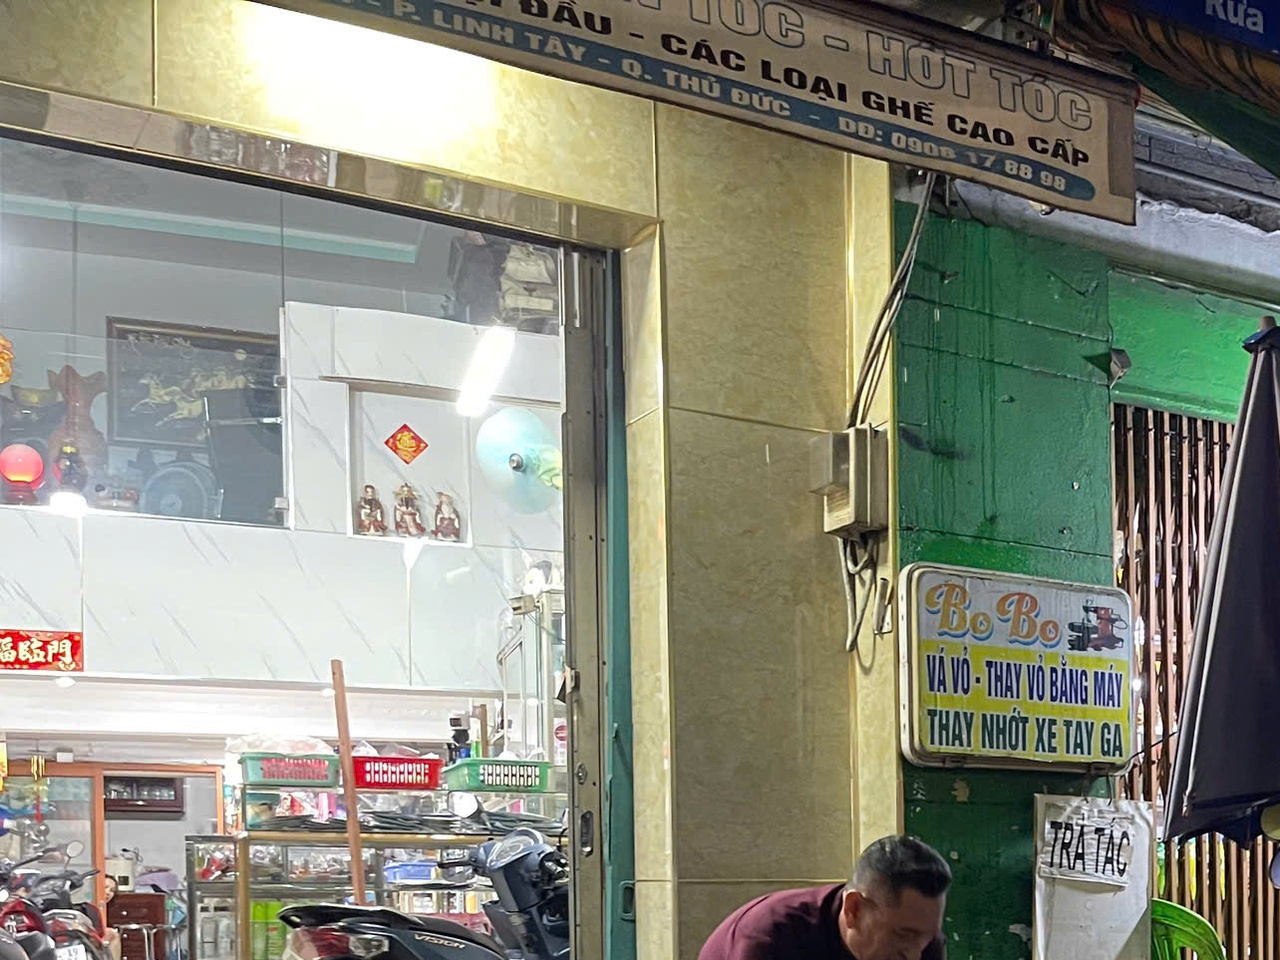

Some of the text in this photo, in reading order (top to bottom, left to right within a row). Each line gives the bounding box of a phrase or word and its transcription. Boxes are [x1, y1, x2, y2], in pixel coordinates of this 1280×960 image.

[433, 9, 515, 45] LINH
[525, 31, 587, 61] TÂY
[621, 58, 653, 80] Q.
[662, 68, 722, 99] THỦ
[1004, 159, 1033, 181] 88
[1039, 172, 1067, 191] 98
[661, 33, 746, 72] CÁC
[761, 59, 848, 103] LOẠI
[861, 90, 935, 126] GHẾ
[947, 114, 1015, 147] CAO
[1028, 136, 1090, 167] CẤP
[925, 582, 1062, 649] Bo Bo
[926, 647, 947, 695] VÁ
[951, 646, 971, 696] VỎ
[985, 660, 1023, 699] THAY
[1027, 653, 1045, 702] VỎ
[1050, 655, 1089, 706] BẰNG
[1093, 663, 1123, 708] MÁY
[927, 706, 1124, 758] THAY NHỚT XE TAY GA
